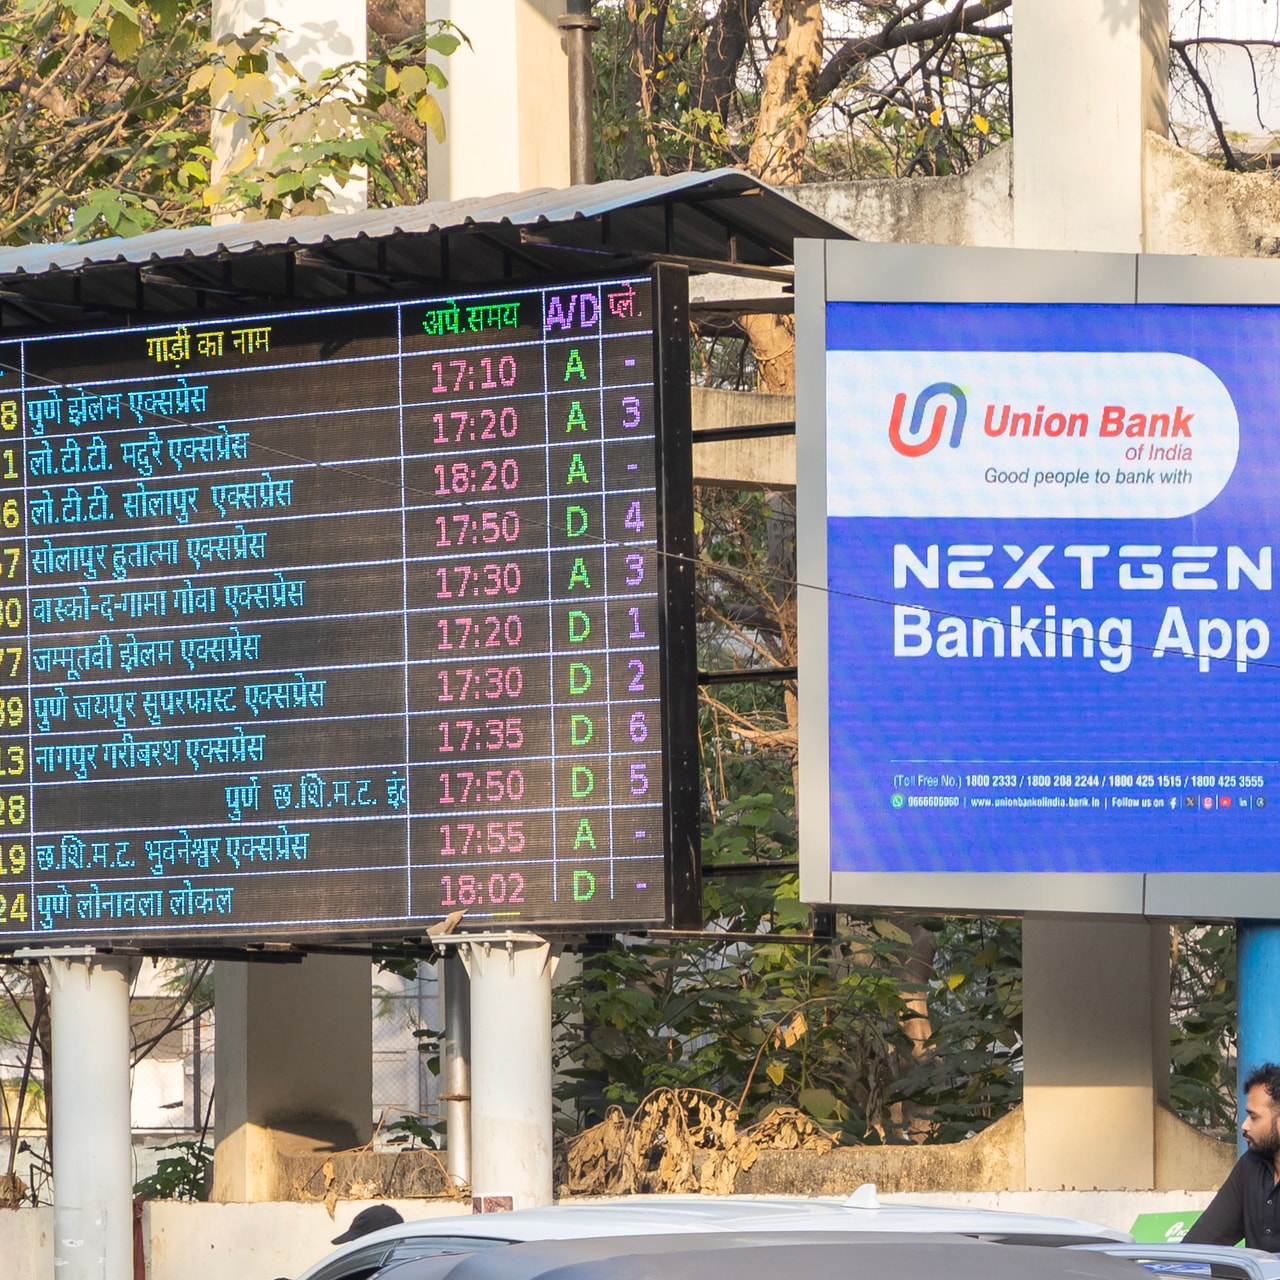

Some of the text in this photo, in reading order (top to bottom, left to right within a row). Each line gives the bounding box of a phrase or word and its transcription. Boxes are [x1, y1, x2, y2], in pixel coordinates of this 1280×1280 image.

[422, 299, 521, 336] अपे.समय
[545, 293, 600, 331] A/D
[147, 327, 271, 368] गाड़ी का नाम
[564, 349, 586, 381] A
[432, 356, 516, 393] 17:10
[27, 379, 208, 435] पुणे झेलम एक्सप्रेस
[567, 403, 587, 432] A
[622, 395, 641, 428] 3
[983, 404, 1196, 438] Union Bank
[433, 407, 517, 443] 17:20
[168, 426, 250, 469] एक्सप्रेस
[1124, 444, 1193, 461] of India
[434, 459, 518, 495] 18:20
[568, 453, 589, 485] A
[984, 467, 1193, 488] Good people to bank with
[120, 482, 199, 524] सोलापुर
[210, 472, 294, 516] एक्सप्रेस
[436, 511, 520, 548] 17:50
[566, 505, 588, 538] D
[624, 500, 645, 533] 4
[30, 538, 108, 580] सोलापुर
[187, 525, 268, 568] एक्सप्रेस
[624, 552, 644, 586] 3
[893, 544, 1273, 591] NEXTGEN
[436, 564, 521, 598] 17:30
[569, 560, 591, 590] A
[173, 579, 217, 615] गोवा
[225, 573, 306, 616] एक्सप्रेस
[438, 615, 522, 651] 17:20
[568, 610, 591, 641] D
[628, 606, 645, 639] 1
[893, 604, 1271, 673] Banking App
[118, 632, 175, 673] झेलम
[180, 626, 261, 670] एक्सप्रेस
[437, 665, 523, 702] 17:30
[569, 663, 592, 695] D
[627, 658, 645, 692] 2
[32, 686, 70, 733] पुणे
[73, 691, 138, 729] जयपुर
[245, 673, 327, 715] एक्सप्रेस
[439, 717, 524, 752] 17:35
[571, 714, 593, 746] D
[628, 710, 649, 743] 6
[34, 726, 266, 781] नागपुर गरीबरथ एक्सप्रेस
[440, 768, 525, 804] 17:50
[573, 766, 594, 798] D
[629, 762, 649, 796] 5
[918, 775, 939, 787] Free
[965, 775, 990, 787] 1800
[992, 775, 1017, 787] 2333
[1027, 775, 1051, 787] 1800
[1053, 775, 1072, 787] 208
[1074, 775, 1099, 787] 2244
[1109, 775, 1133, 787] 1800
[1135, 775, 1154, 787] 425
[1157, 775, 1182, 787] 1515
[1191, 775, 1215, 787] 1800
[1218, 775, 1237, 787] 425
[1239, 775, 1264, 787] 3555
[224, 775, 262, 822] पुणे
[1112, 796, 1139, 807] Follow
[1142, 798, 1152, 808] us
[1153, 798, 1165, 808] on
[226, 825, 310, 867] एक्सप्रेस
[440, 820, 526, 856] 17:55
[574, 820, 596, 848] A
[441, 871, 525, 907] 18:02
[574, 872, 596, 901] D
[36, 883, 73, 931] पुणे
[168, 878, 234, 915] लोकल
